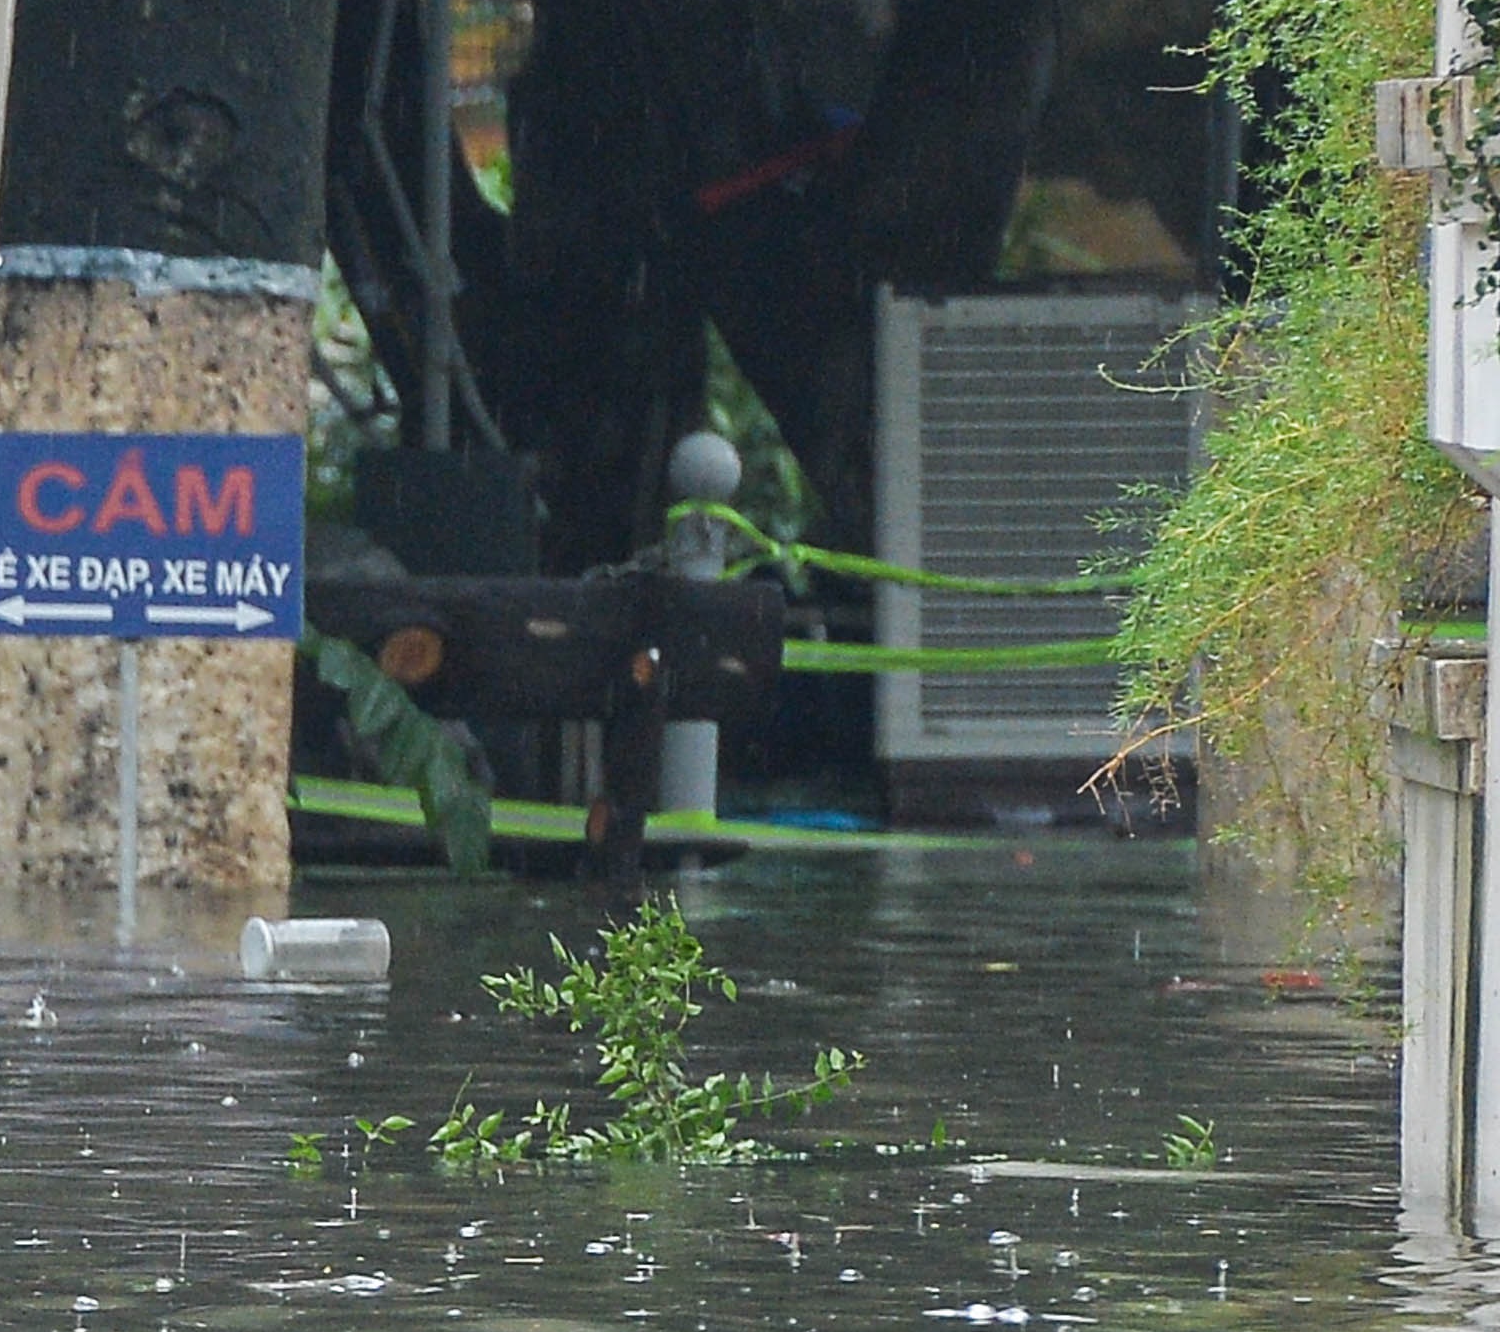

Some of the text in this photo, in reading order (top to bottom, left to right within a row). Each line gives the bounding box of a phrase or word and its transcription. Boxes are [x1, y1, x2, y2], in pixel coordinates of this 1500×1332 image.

[16, 447, 255, 537] CẤM
[26, 555, 70, 590] XE
[78, 557, 153, 599] ĐẠP,
[163, 559, 207, 595] XE
[215, 553, 291, 597] MÁY
